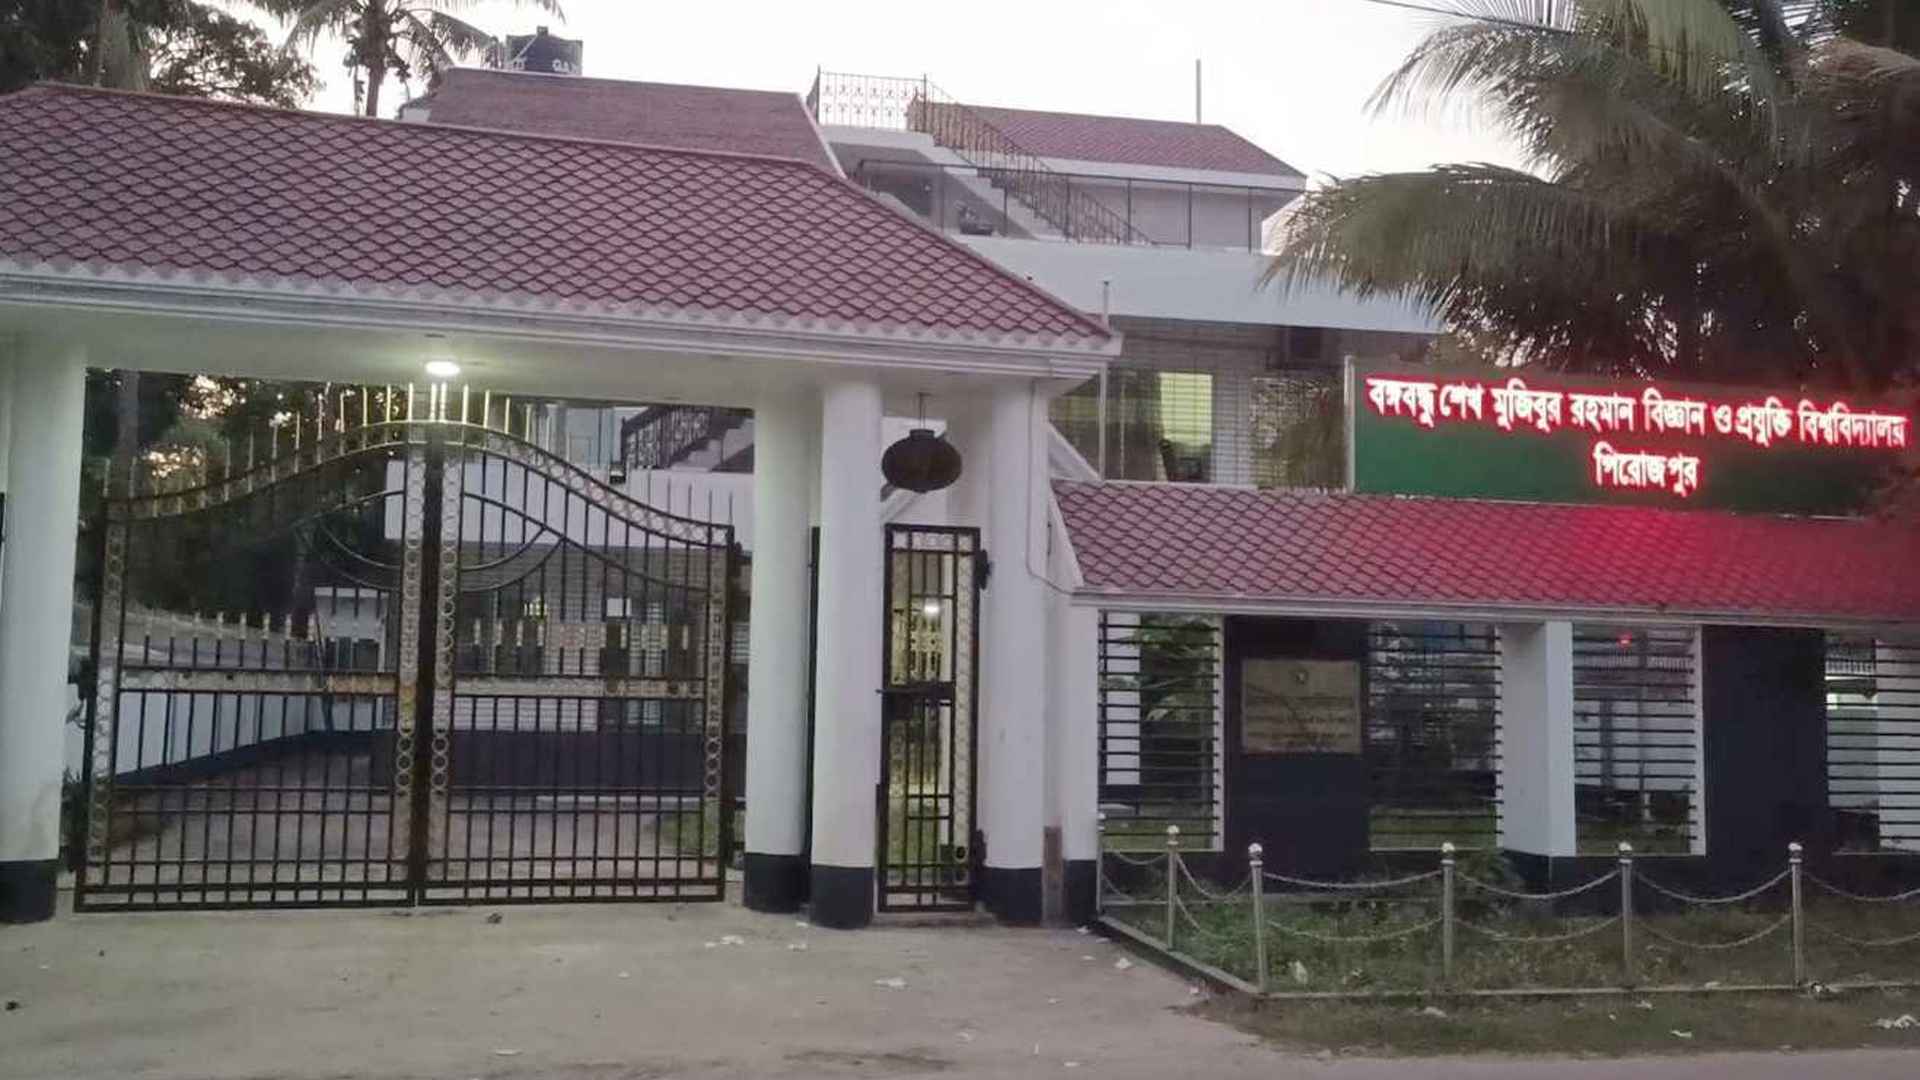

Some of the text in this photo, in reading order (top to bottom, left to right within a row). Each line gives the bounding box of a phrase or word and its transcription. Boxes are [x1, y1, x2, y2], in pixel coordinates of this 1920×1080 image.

[1366, 378, 1438, 428] বঙ্গবন্ধু
[1439, 382, 1485, 420] শেখ
[1490, 377, 1563, 433] মুজিবুর
[1567, 392, 1637, 433] রহমান
[1641, 387, 1707, 436] বিজ্ঞান
[1711, 404, 1732, 433] ও
[1735, 396, 1793, 447] প্রযুক্তি
